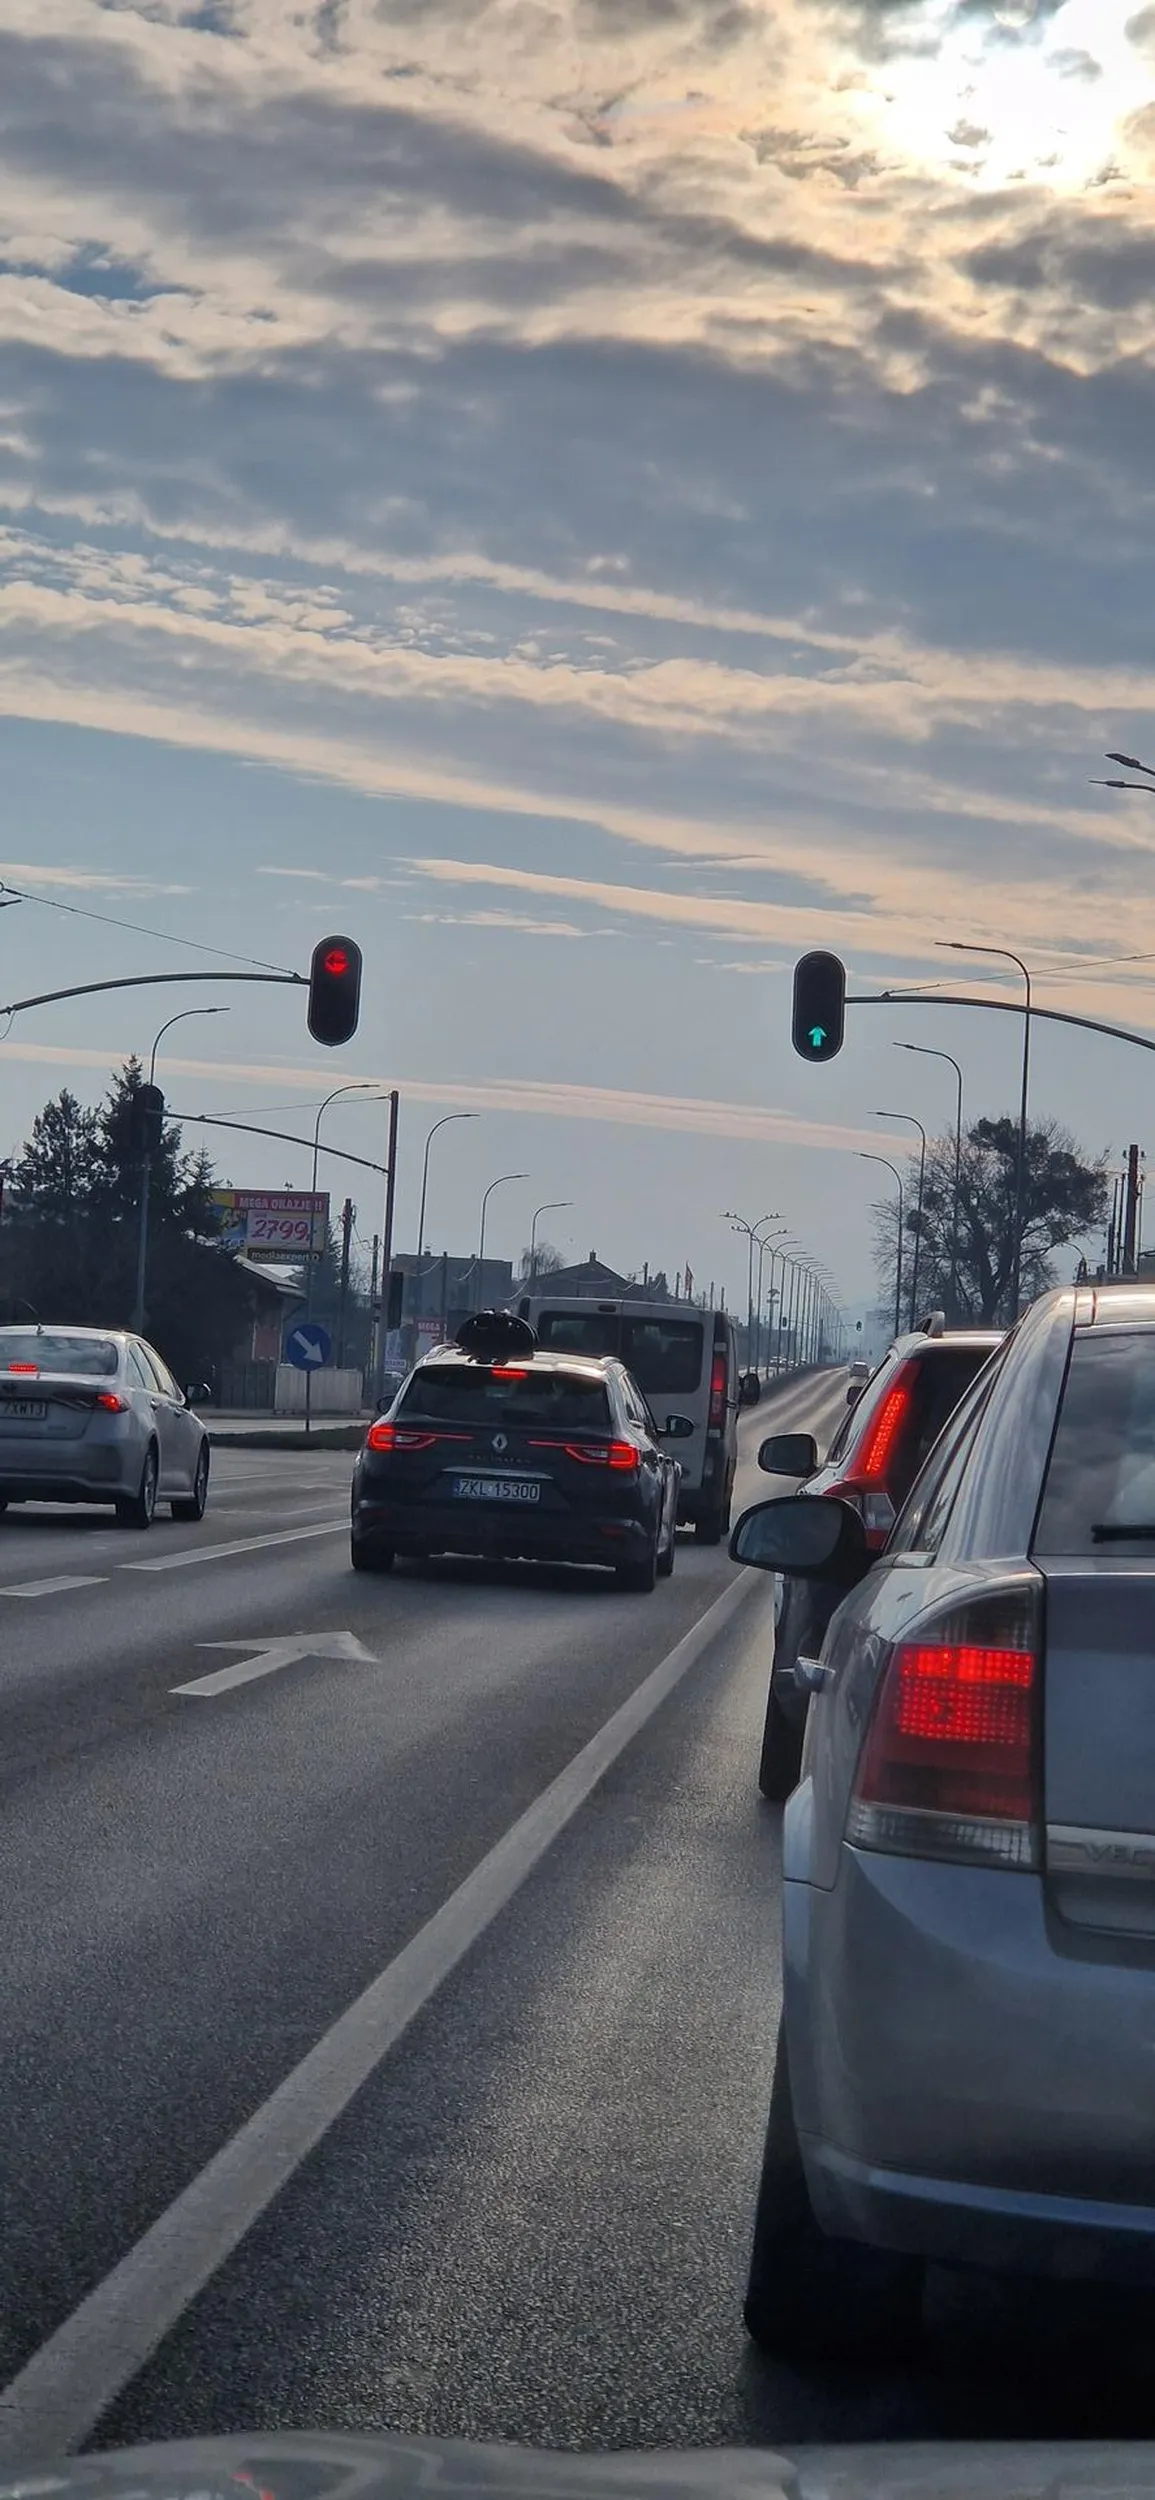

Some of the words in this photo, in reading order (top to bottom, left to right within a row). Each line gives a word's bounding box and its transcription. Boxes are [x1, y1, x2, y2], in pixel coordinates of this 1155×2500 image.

[238, 1197, 269, 1209] MEGA
[271, 1199, 312, 1211] OKAZJE
[460, 1480, 487, 1496] ZKL
[495, 1481, 539, 1499] 15300
